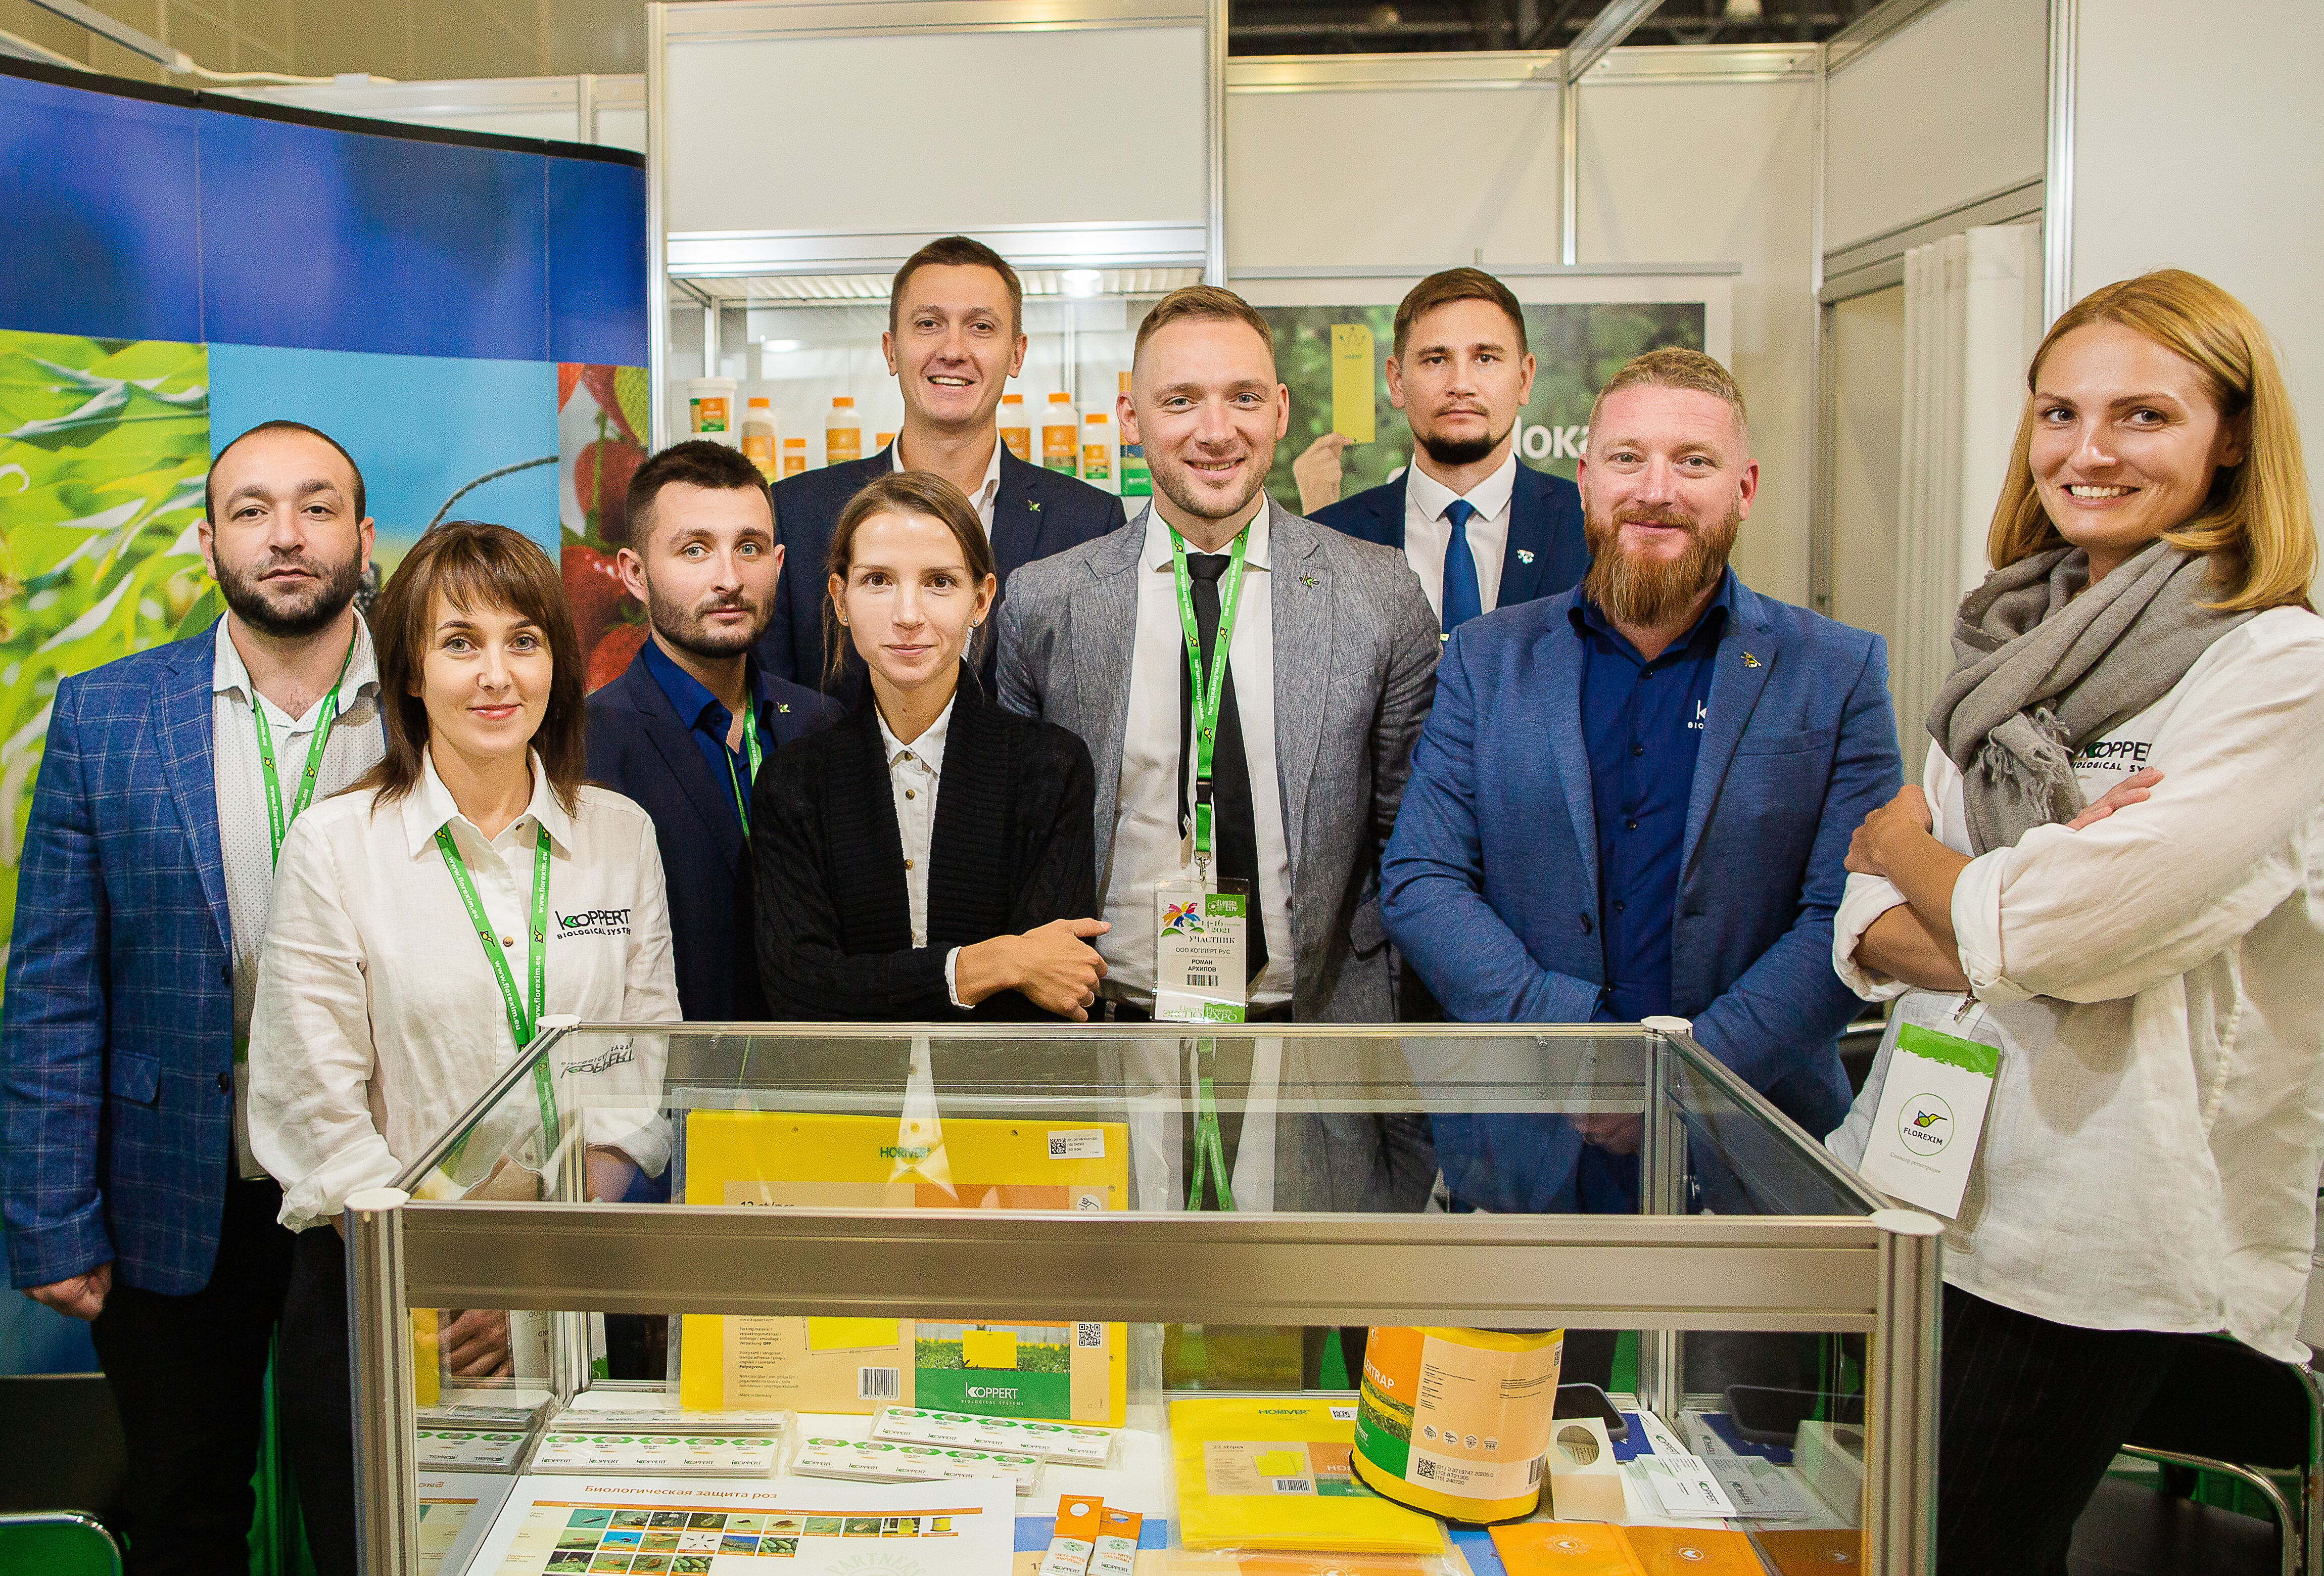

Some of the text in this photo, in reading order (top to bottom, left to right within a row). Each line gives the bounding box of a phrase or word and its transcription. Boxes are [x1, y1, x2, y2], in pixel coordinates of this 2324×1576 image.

[1179, 564, 1192, 620] www.florexim.eu
[1224, 558, 1238, 617] www.florexim.eu
[1194, 659, 1204, 720] www.florexim.eu
[1208, 655, 1221, 716] www.florexim.eu
[314, 695, 334, 751] www.florexim.eu
[269, 785, 280, 849] www.florexim.eu
[538, 851, 548, 913] www.florexim.eu
[448, 856, 479, 920] www.florexim.eu
[555, 909, 631, 930] KOPPERT
[557, 928, 606, 940] BIOLOGICAL
[494, 960, 520, 1031] www.florexim.eu
[1903, 1127, 1943, 1145] FLOREXIM
[965, 1381, 1019, 1400] KOPPERT
[882, 1428, 912, 1436] KOPPERT
[928, 1432, 958, 1441] KOPPERT
[974, 1437, 1004, 1446] KOPPERT
[1020, 1442, 1051, 1450] KOPPERT
[1067, 1446, 1098, 1455] KOPPERT
[848, 1462, 879, 1470] KOPPERT
[896, 1466, 927, 1474] KOPPERT
[943, 1470, 975, 1479] KOPPERT
[1452, 1468, 1474, 1476] 8719747
[585, 1485, 692, 1497] Биологическая
[696, 1489, 749, 1498] защита
[1055, 1552, 1086, 1563] ULTI-MITE
[1056, 1556, 1082, 1565] SWIRSKI
[1103, 1555, 1130, 1563] SWIRSKI
[1052, 1563, 1080, 1573] KOPPERT
[1101, 1561, 1129, 1572] KOPPERT
